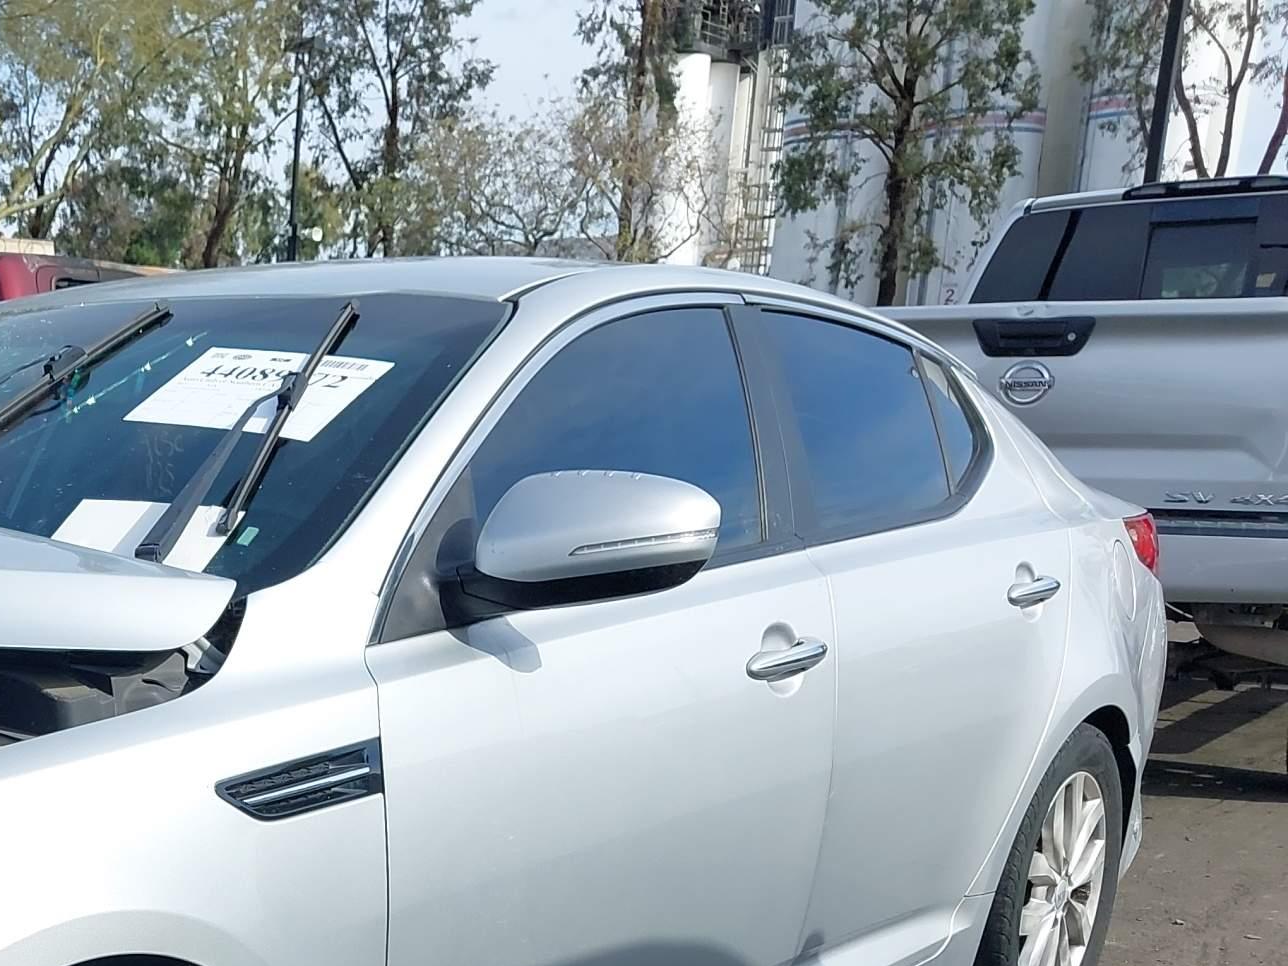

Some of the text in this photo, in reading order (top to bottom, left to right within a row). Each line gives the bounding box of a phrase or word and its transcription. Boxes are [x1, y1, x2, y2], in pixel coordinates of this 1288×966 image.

[200, 364, 349, 389] 4408972
[1006, 380, 1047, 389] NISSAN
[1163, 489, 1214, 504] SV
